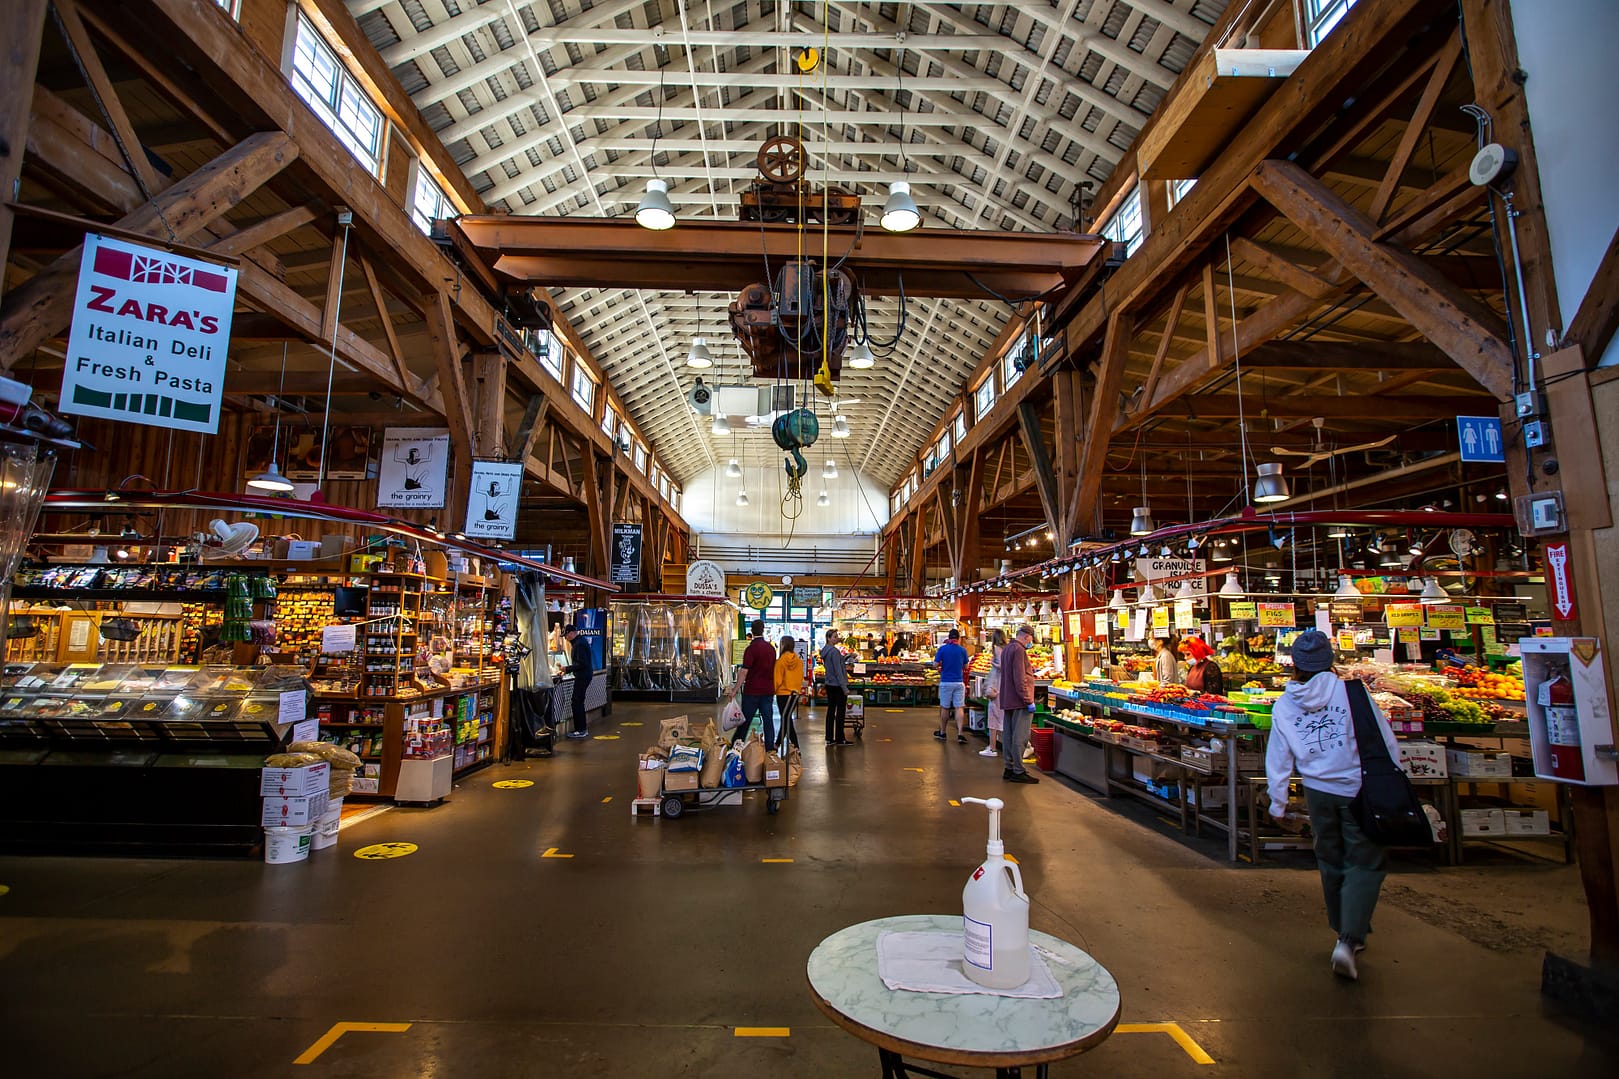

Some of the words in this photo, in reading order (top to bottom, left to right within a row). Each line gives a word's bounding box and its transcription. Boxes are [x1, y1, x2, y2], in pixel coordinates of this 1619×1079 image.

[86, 285, 219, 334] ZARA'S
[88, 324, 158, 351] Italian
[170, 340, 212, 361] Deli
[144, 354, 155, 366] &
[76, 356, 142, 382] Fresh
[154, 370, 212, 394] Pasta
[391, 492, 404, 500] the
[406, 492, 432, 501] grainry
[486, 524, 510, 532] grainry
[694, 582, 718, 590] DUSSA'S
